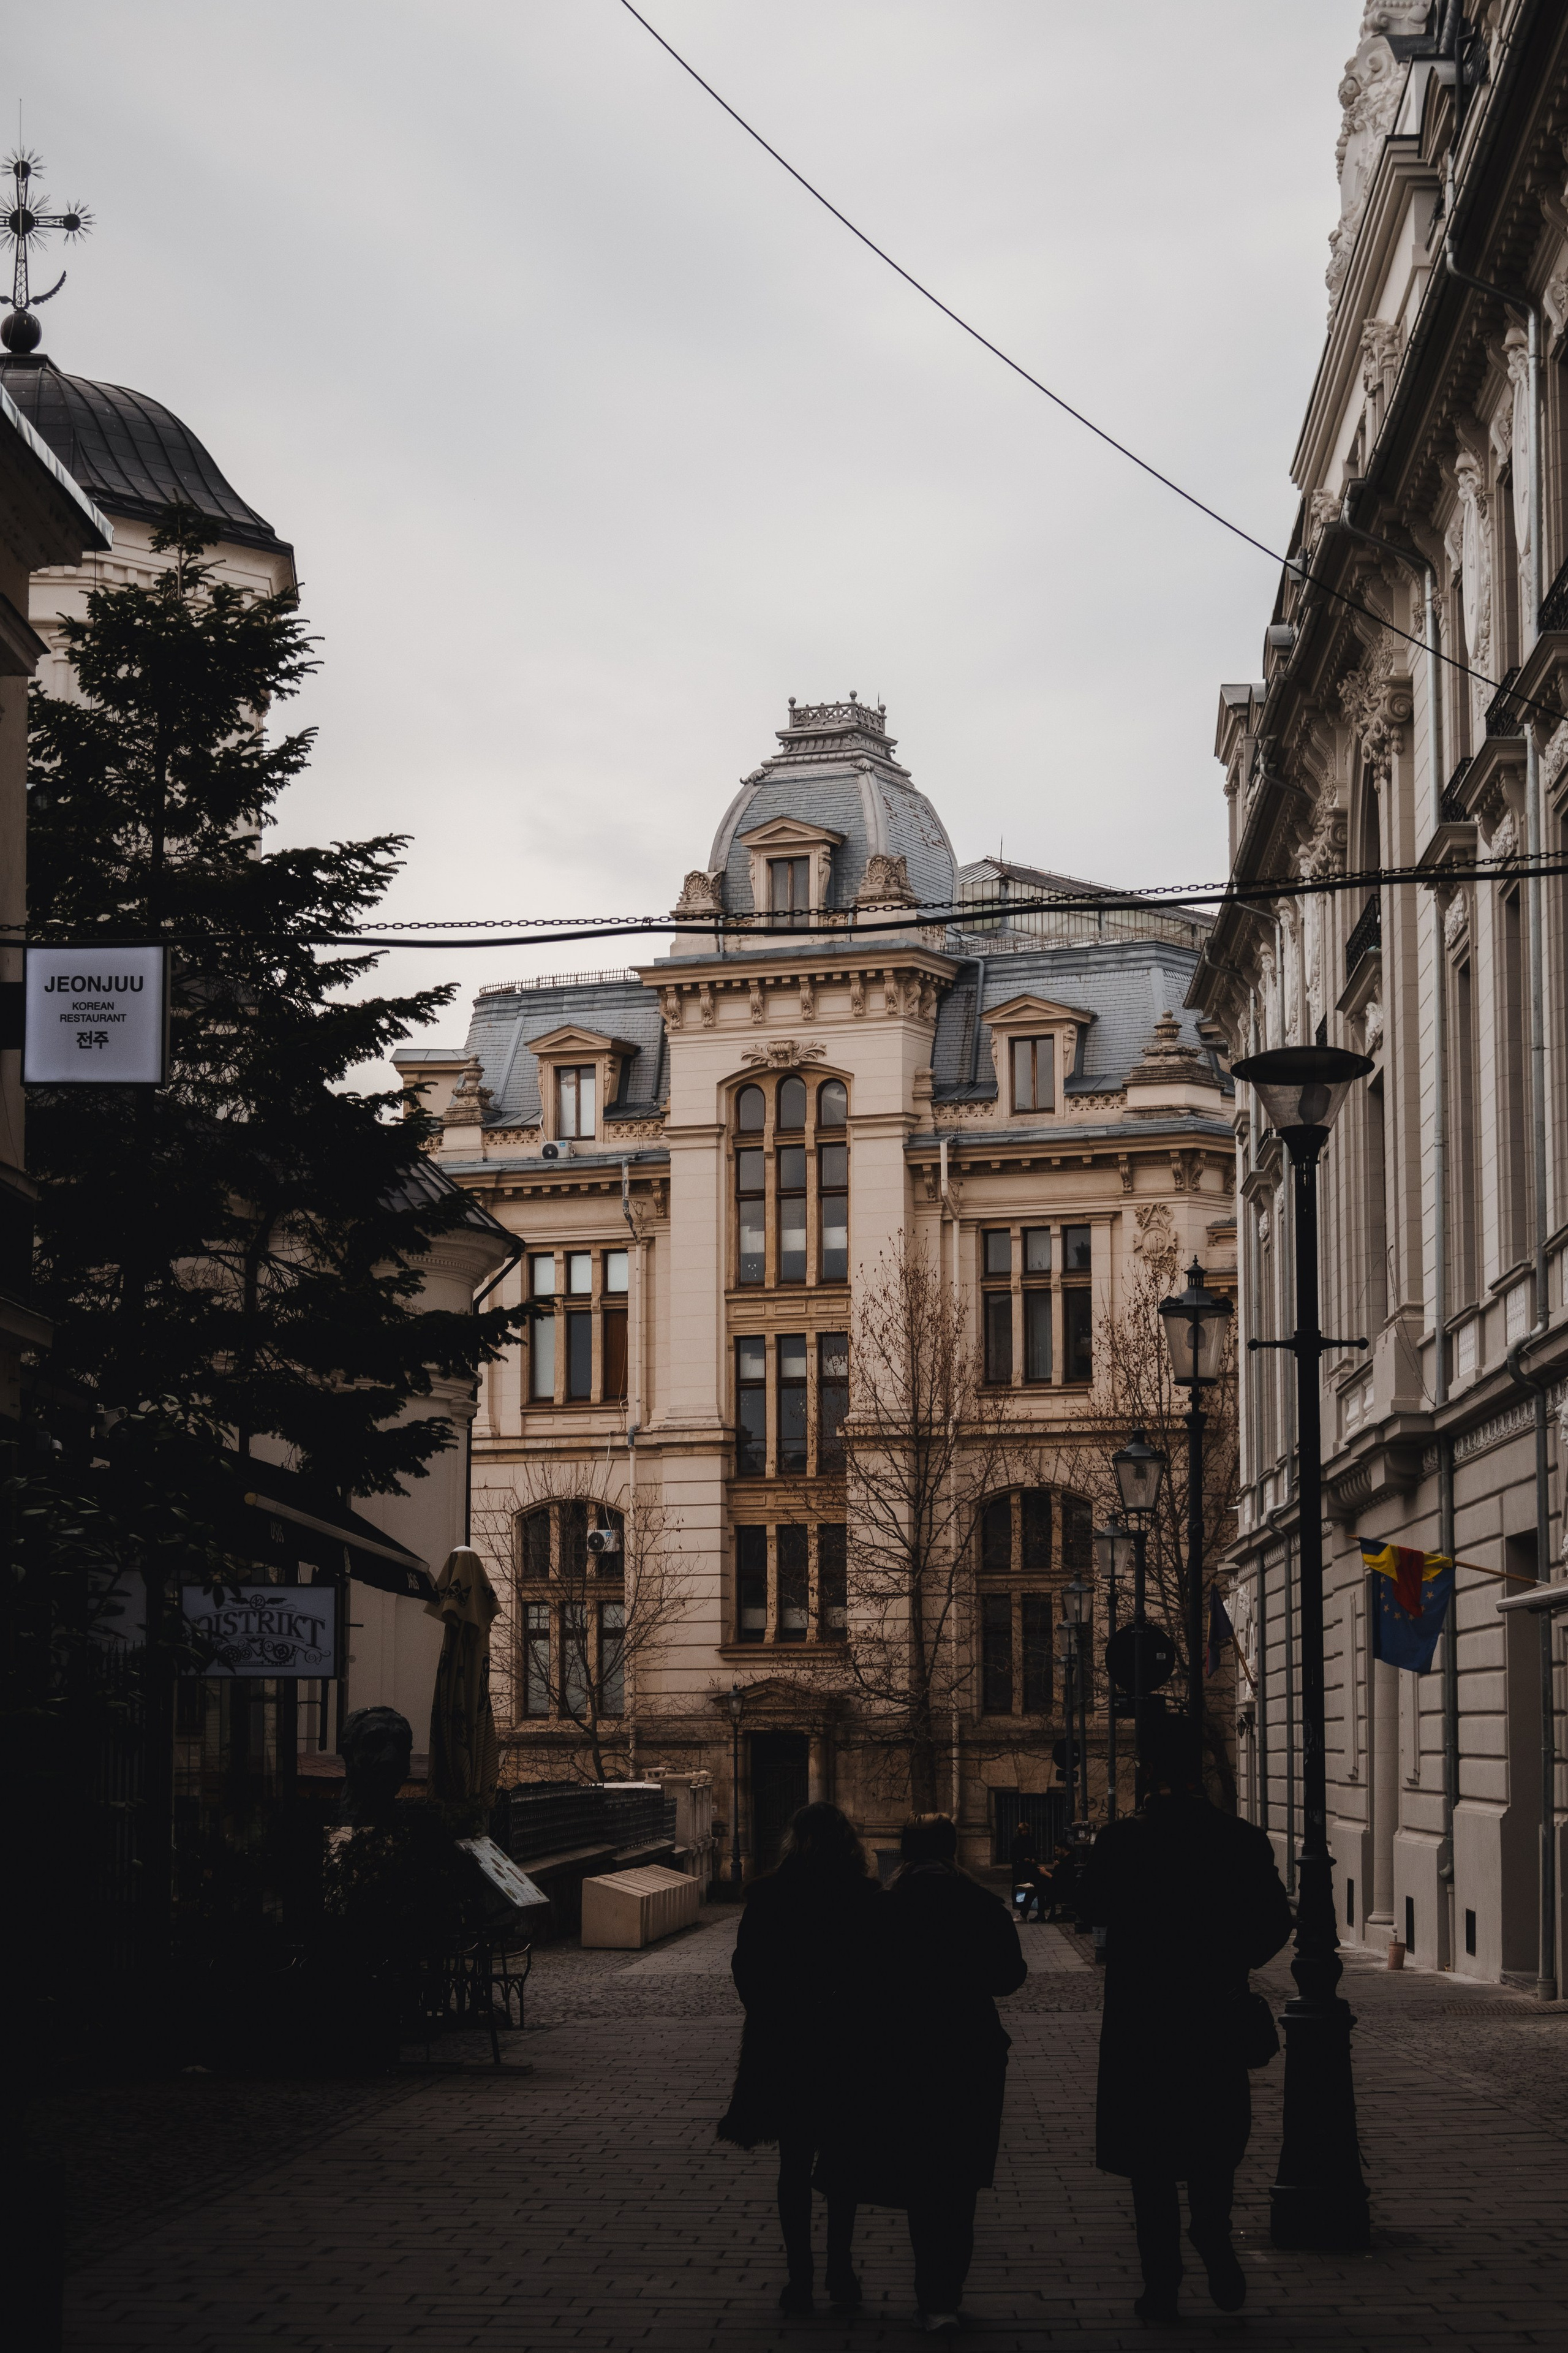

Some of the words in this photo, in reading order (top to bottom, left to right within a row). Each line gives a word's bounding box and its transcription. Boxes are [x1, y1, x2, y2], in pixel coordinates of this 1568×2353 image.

[44, 975, 144, 992] JEONJUU
[72, 1002, 115, 1011] KOREAN
[60, 1014, 127, 1022] RESTAURANT
[76, 1030, 109, 1049] 전주
[252, 1598, 263, 1607] 42
